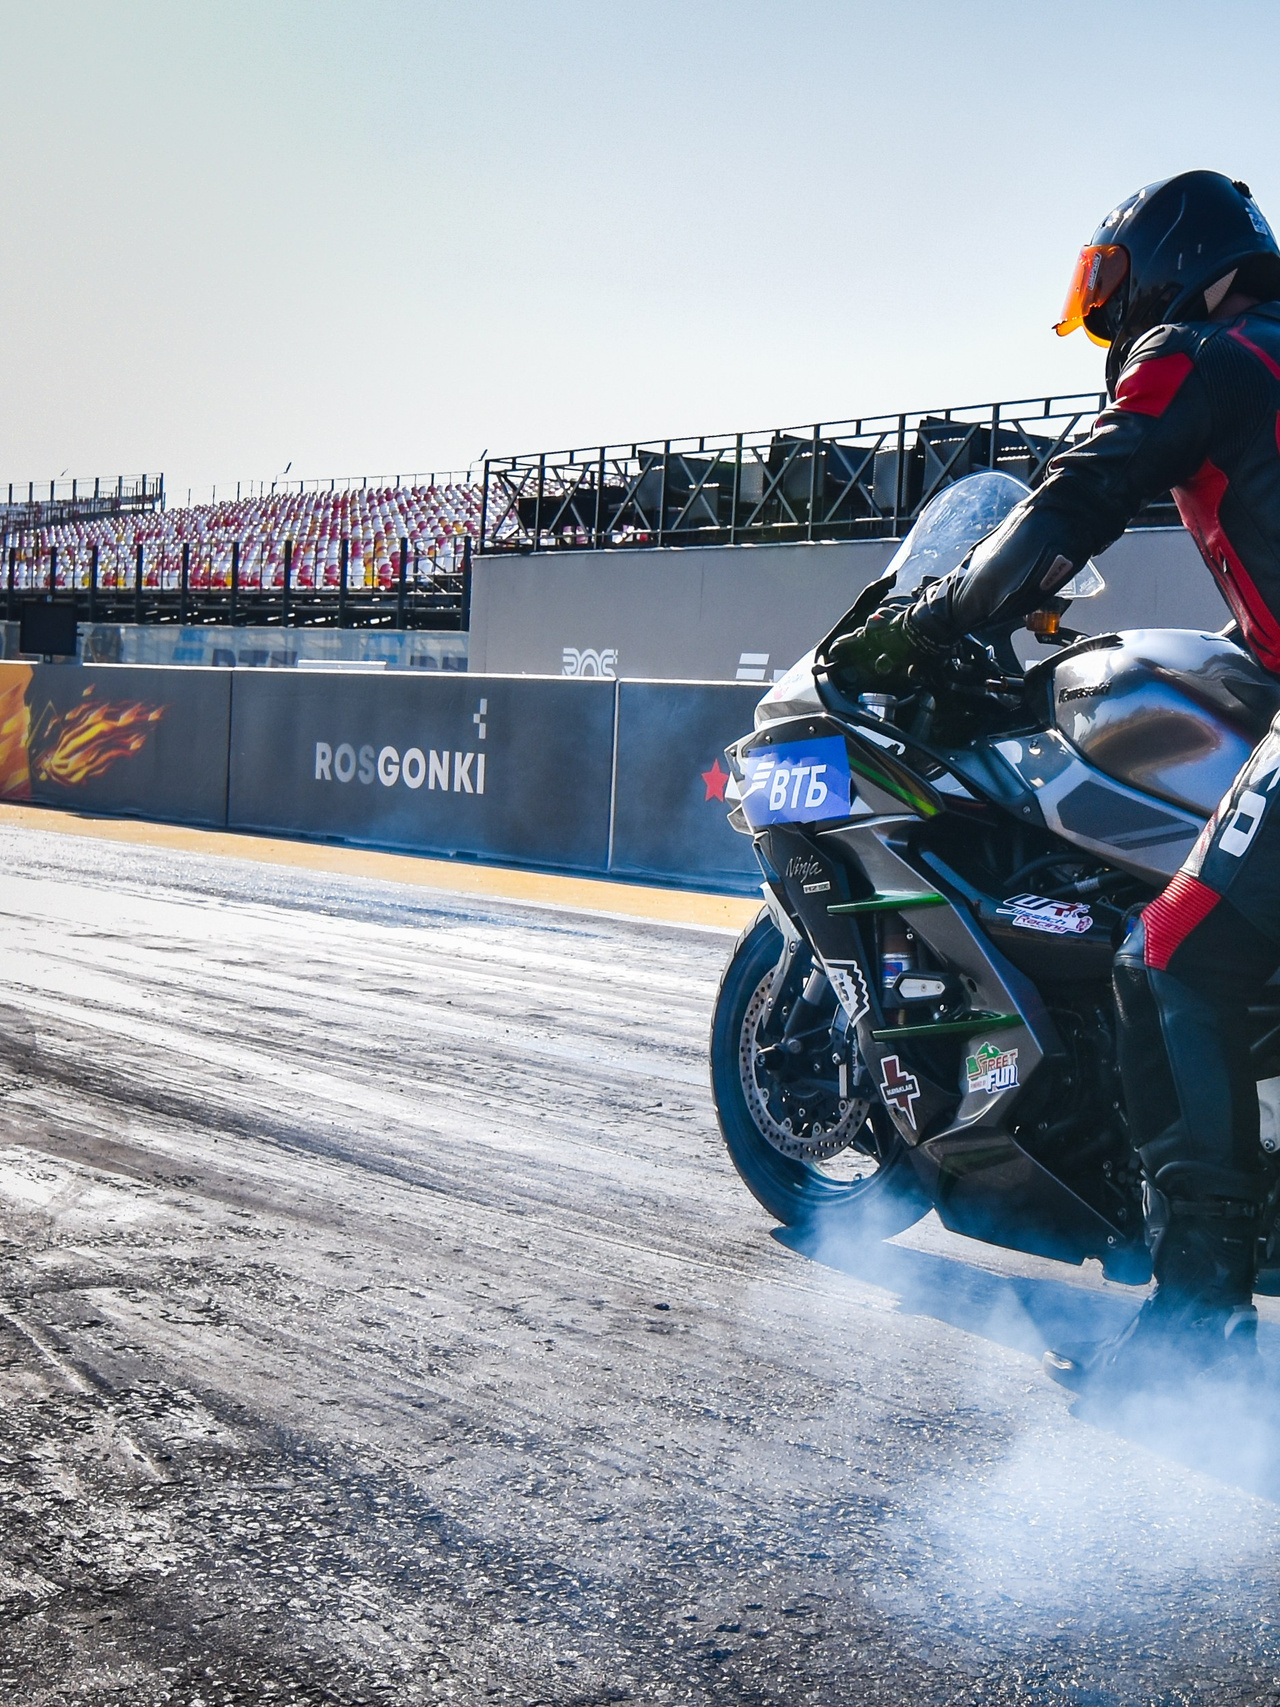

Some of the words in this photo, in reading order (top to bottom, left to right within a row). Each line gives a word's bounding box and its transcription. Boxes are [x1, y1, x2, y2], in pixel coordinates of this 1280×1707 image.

[315, 742, 486, 795] ROSGONKI
[769, 764, 828, 811] ВТБ
[785, 855, 822, 883] Ninja
